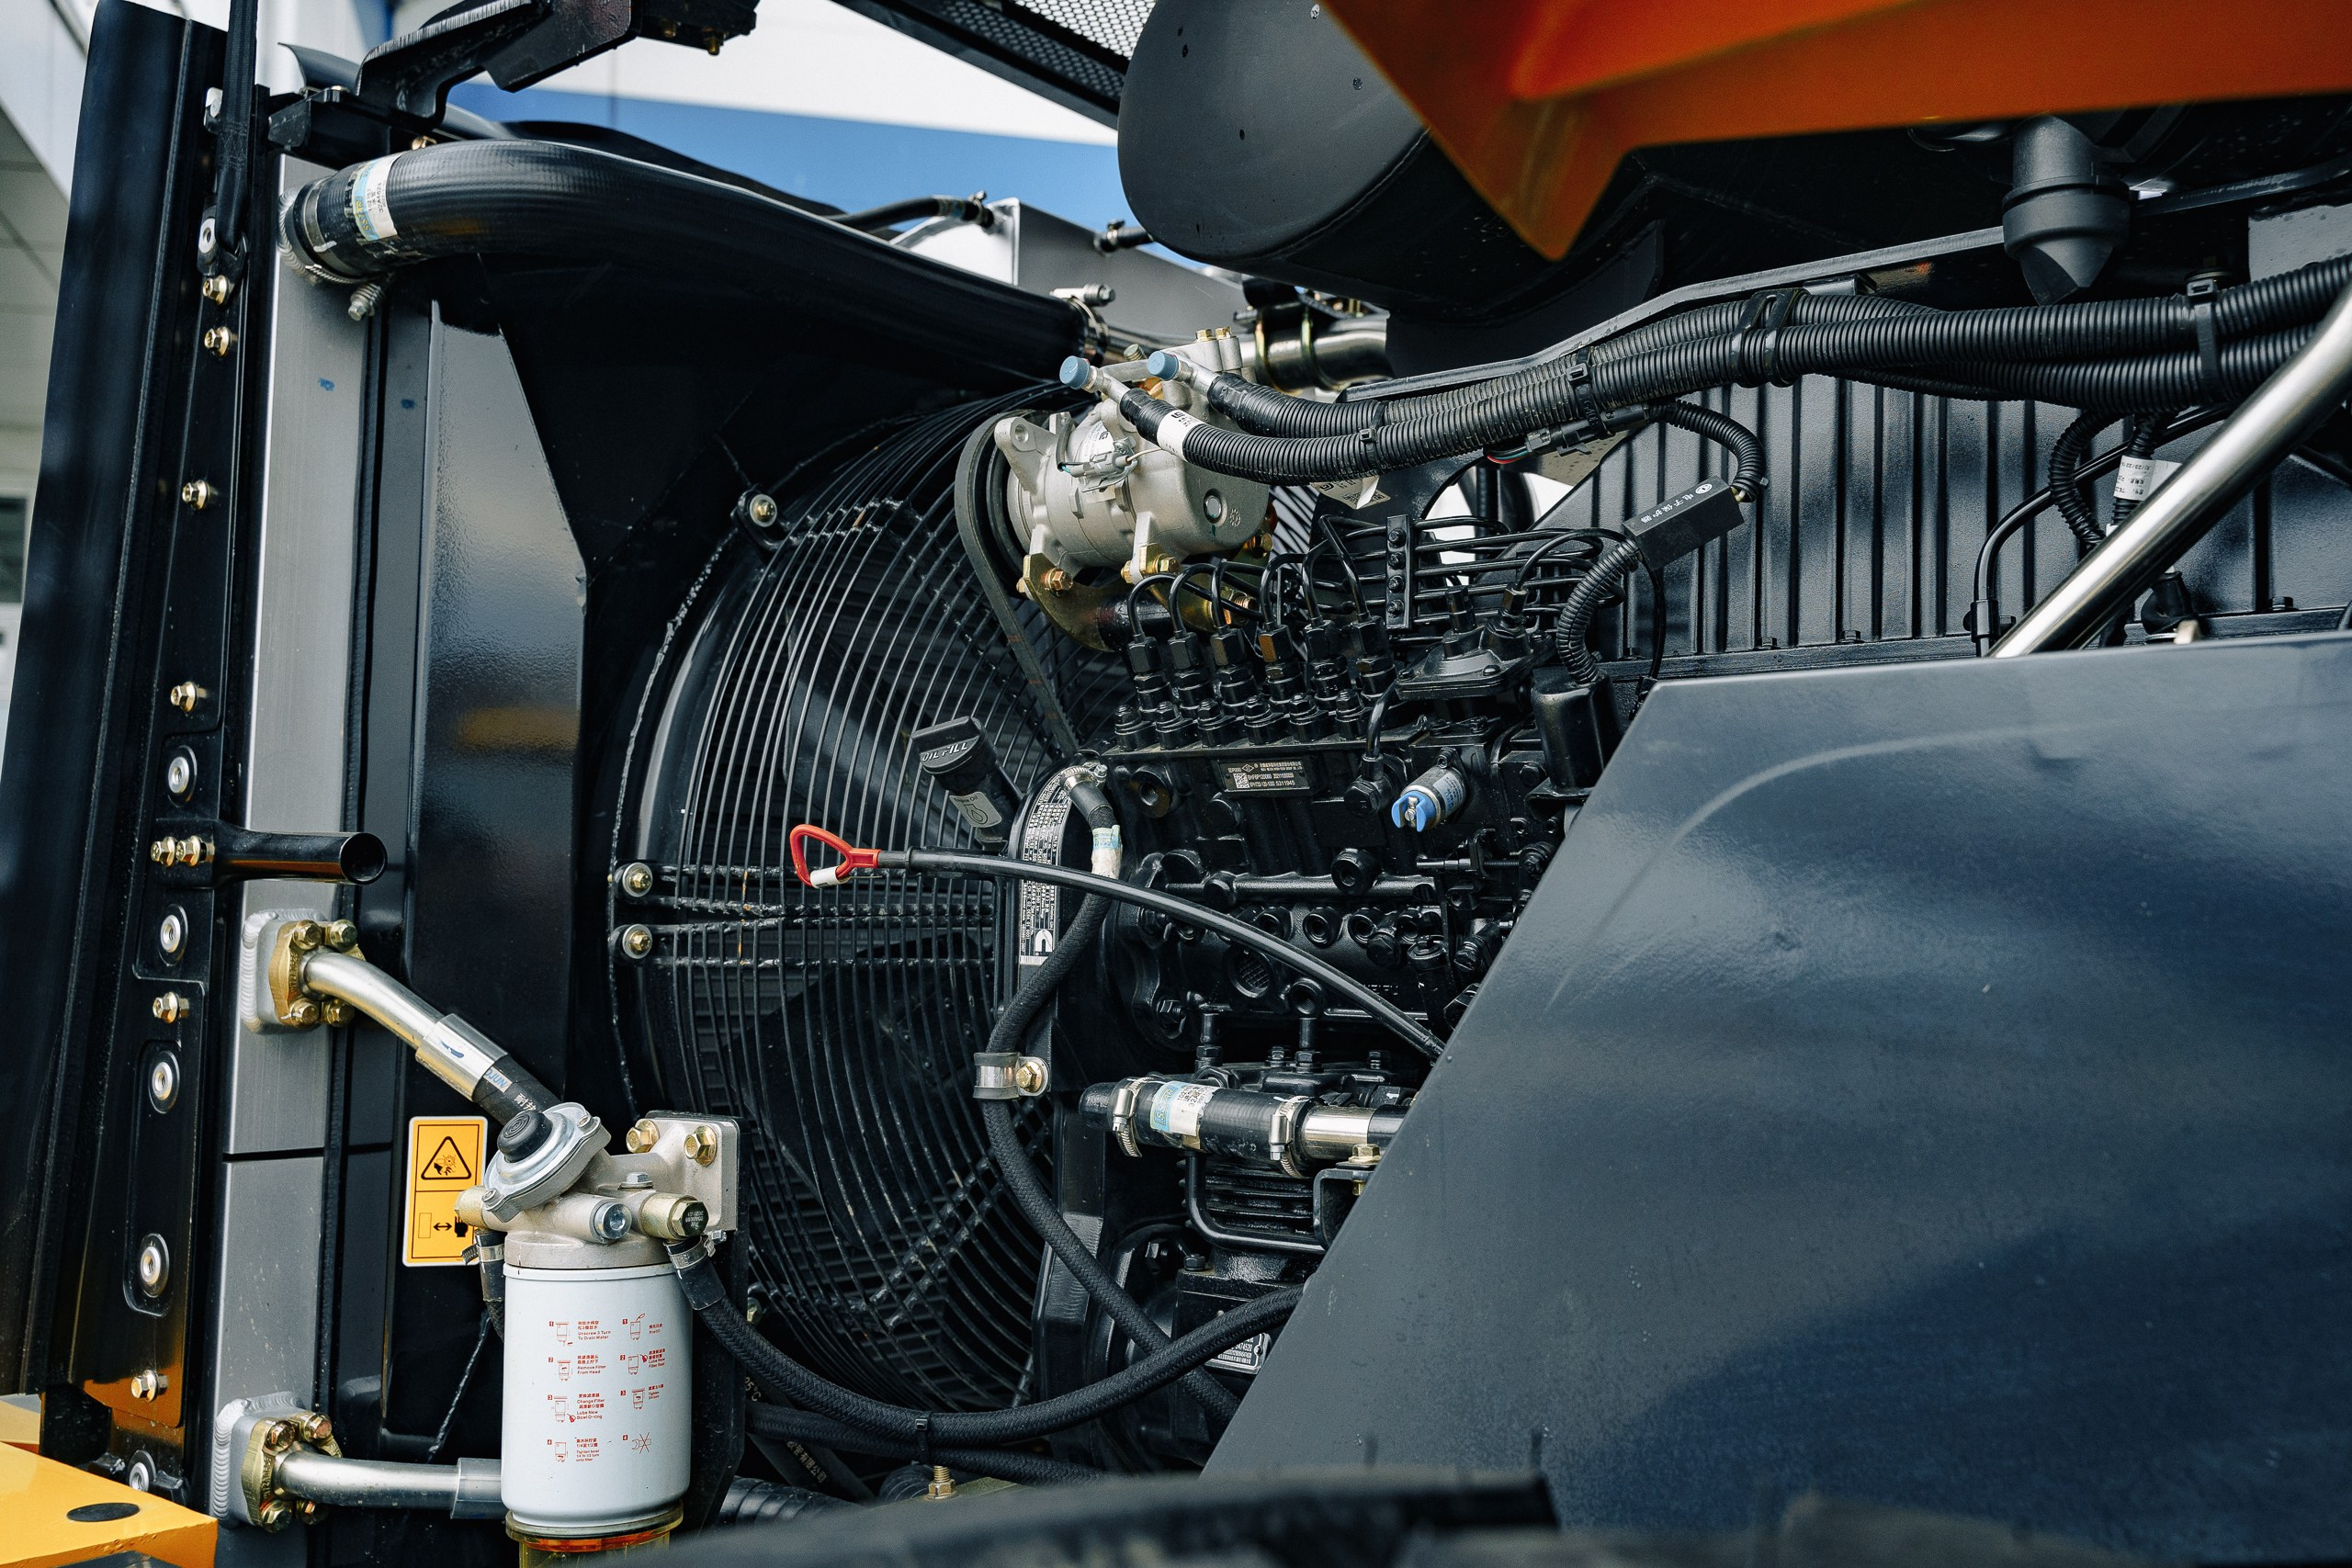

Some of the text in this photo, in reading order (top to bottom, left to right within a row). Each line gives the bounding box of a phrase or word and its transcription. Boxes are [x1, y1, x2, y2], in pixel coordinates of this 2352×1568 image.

[1640, 493, 1694, 524] 电子保护器
[922, 742, 967, 761] OIL FILL
